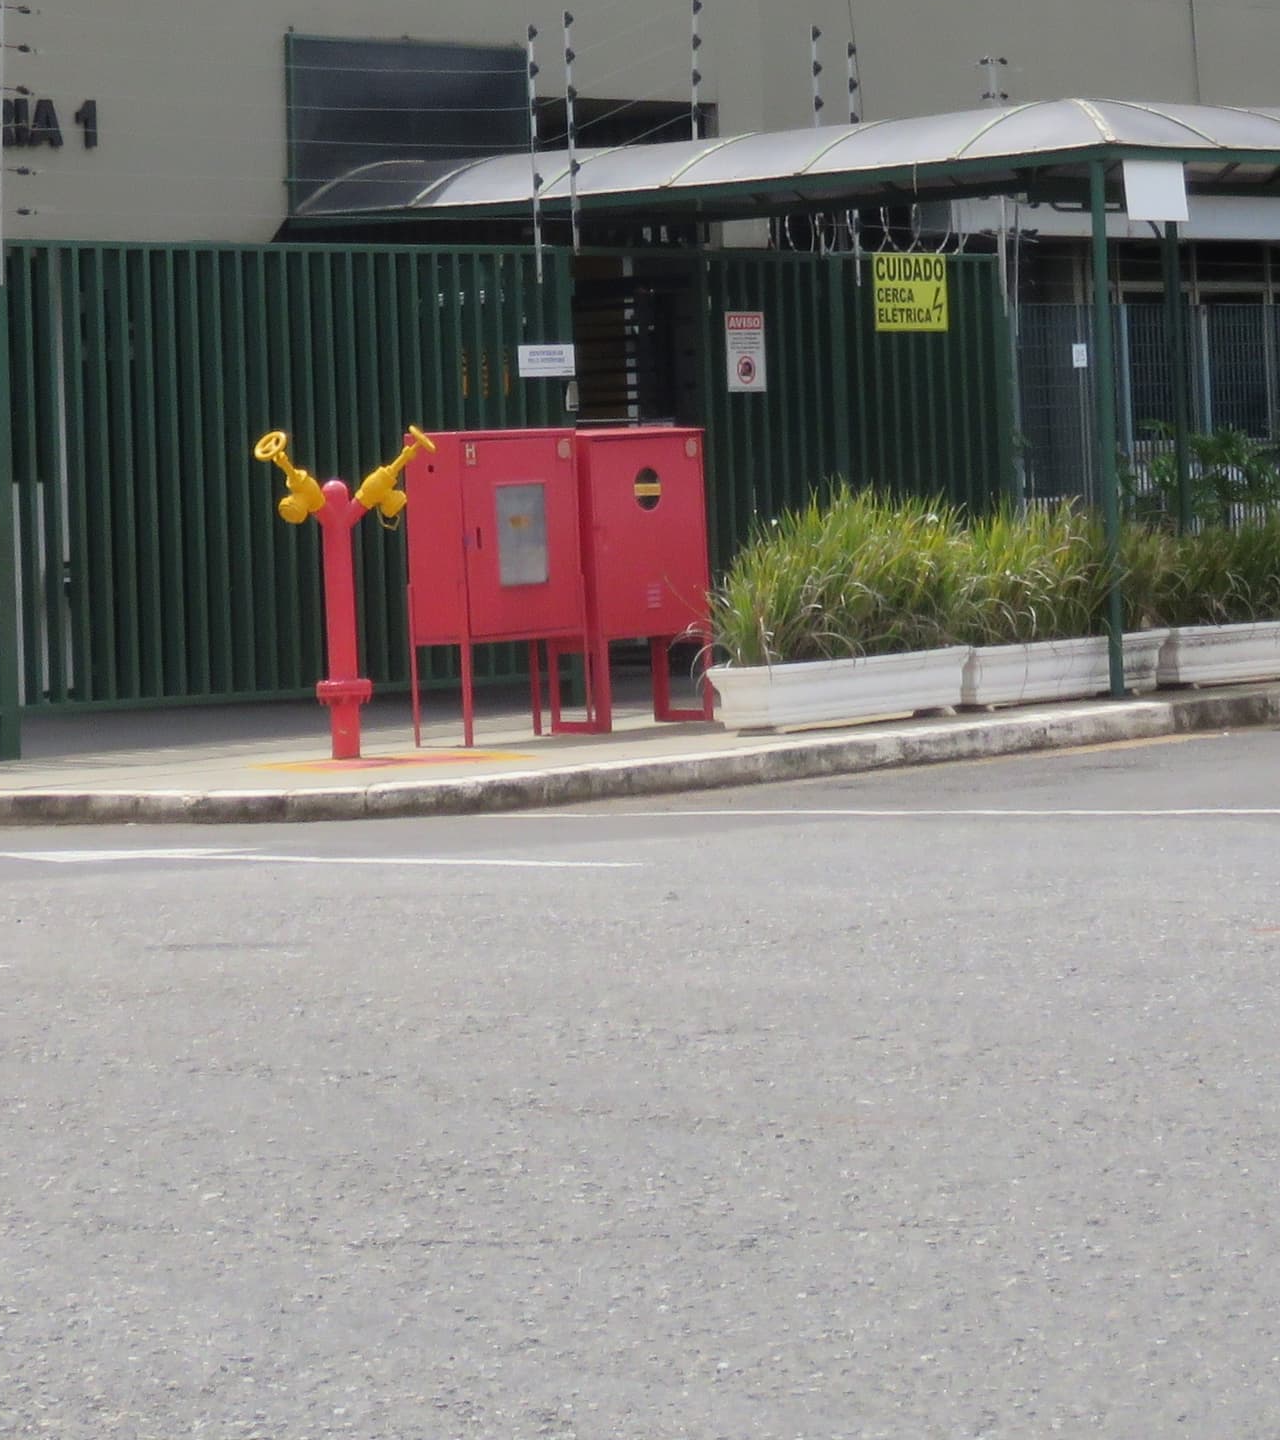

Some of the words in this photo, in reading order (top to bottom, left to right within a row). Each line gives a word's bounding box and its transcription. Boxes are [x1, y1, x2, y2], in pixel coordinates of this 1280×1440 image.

[75, 99, 99, 149] 1
[875, 257, 944, 282] CUIDADO
[877, 287, 915, 303] CERCA
[728, 316, 761, 329] AVISO
[878, 304, 933, 323] ELÉTRICA
